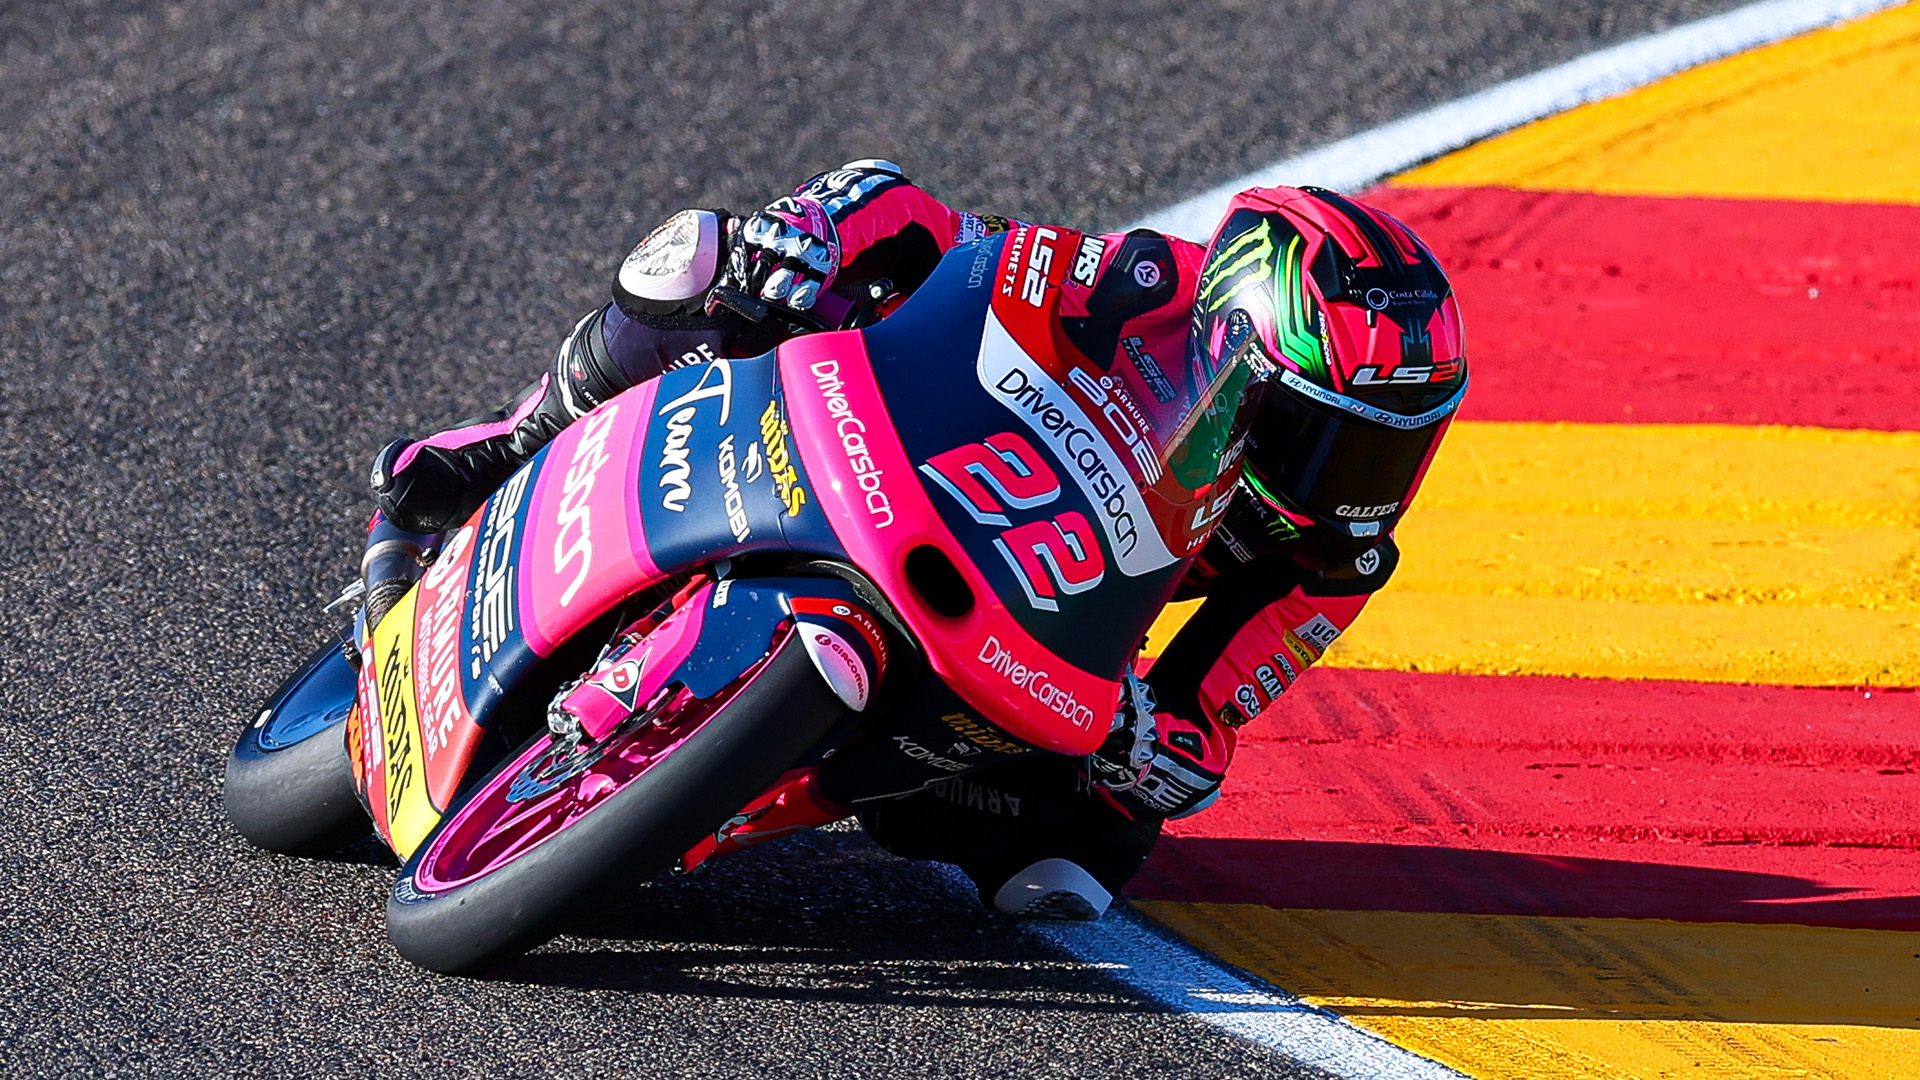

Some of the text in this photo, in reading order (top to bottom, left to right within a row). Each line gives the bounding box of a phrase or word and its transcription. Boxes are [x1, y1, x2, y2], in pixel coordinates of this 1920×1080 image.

[1002, 227, 1028, 298] HELMETS
[1021, 228, 1057, 307] LS2
[1073, 236, 1106, 287] WRS
[1113, 388, 1150, 434] ARMURE
[1302, 384, 1341, 405] HYUNDAI
[1352, 364, 1460, 386] LS2
[1393, 411, 1441, 427] HYUNDAI
[658, 358, 733, 513] Team
[810, 360, 895, 528] DriverCarsbcn
[996, 368, 1138, 558] DriverCarsbcn
[1068, 366, 1163, 486] BOE
[718, 434, 751, 543] KOMOBI
[918, 432, 1105, 612] 22
[1335, 501, 1400, 518] GALFER
[482, 460, 536, 664] BOE
[430, 565, 466, 749] ARMURE
[978, 636, 1094, 731] DriverCarsbcn
